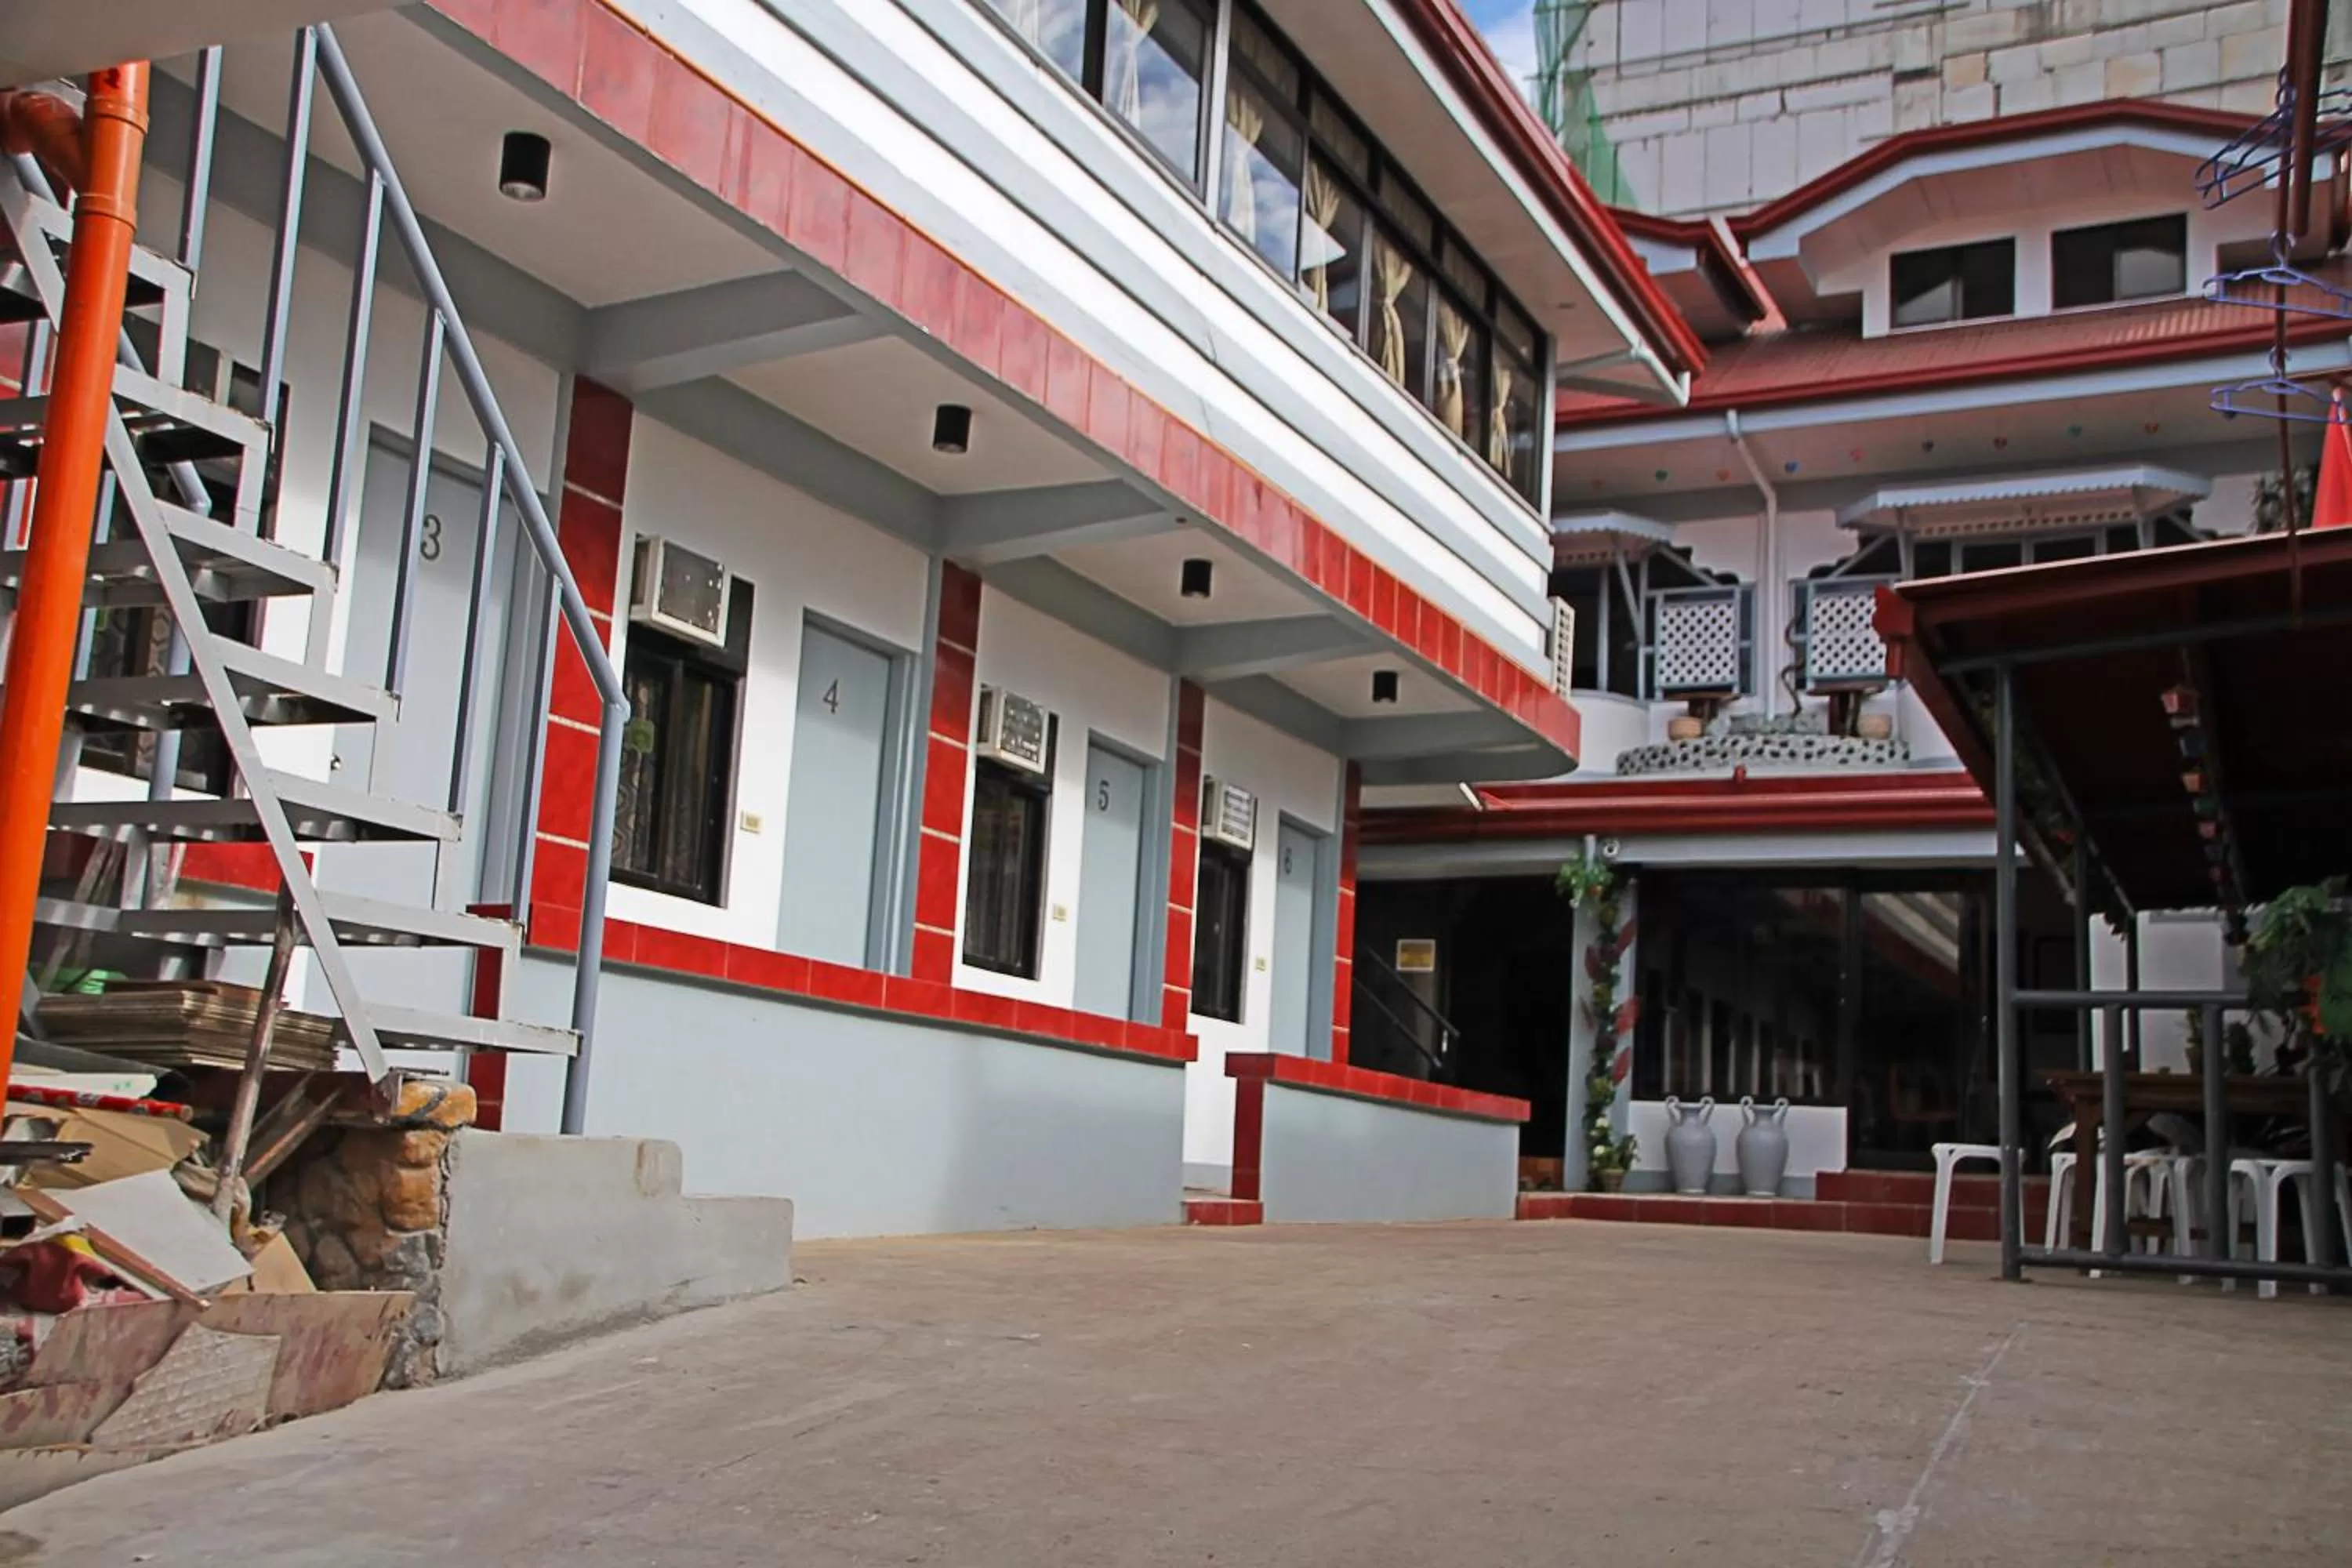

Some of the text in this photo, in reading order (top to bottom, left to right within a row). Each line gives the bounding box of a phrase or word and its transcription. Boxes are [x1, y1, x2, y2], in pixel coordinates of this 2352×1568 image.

[420, 514, 441, 561] 3
[822, 678, 839, 714] 4
[1098, 779, 1110, 812] 5
